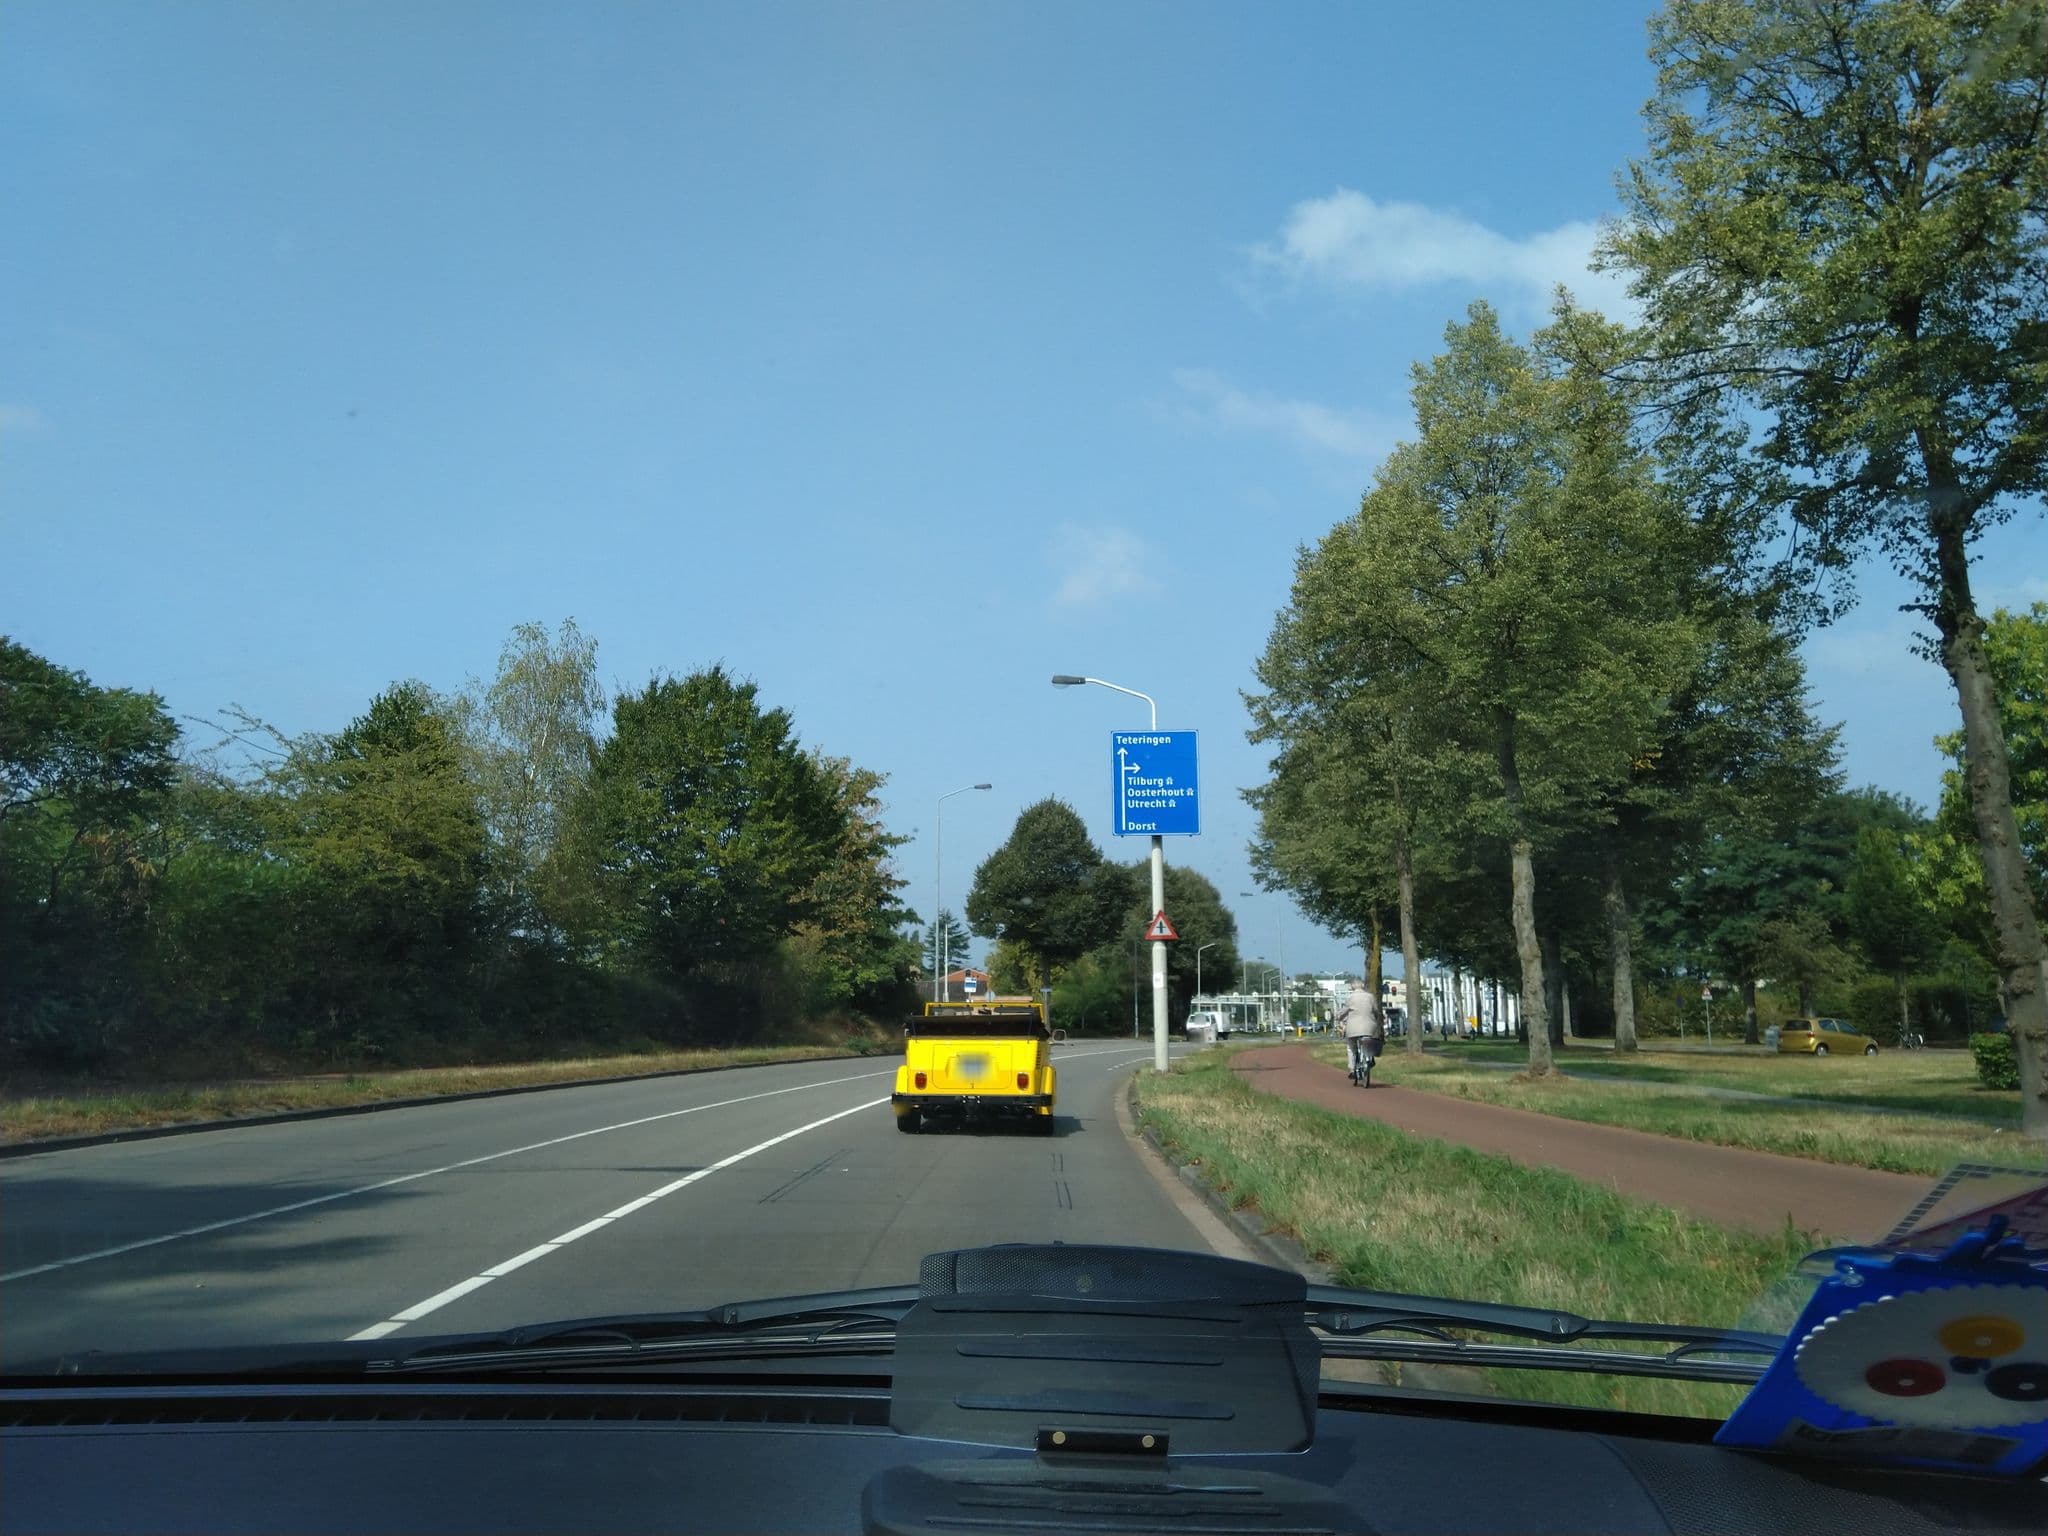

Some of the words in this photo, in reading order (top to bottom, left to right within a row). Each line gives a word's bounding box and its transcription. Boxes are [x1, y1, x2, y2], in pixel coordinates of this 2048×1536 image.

[1116, 736, 1171, 746] Teteringen
[1127, 777, 1164, 787] Tilburg
[1127, 788, 1185, 797] Oosterhout
[1127, 799, 1167, 808] Utrecht
[1128, 822, 1157, 831] Dorst
